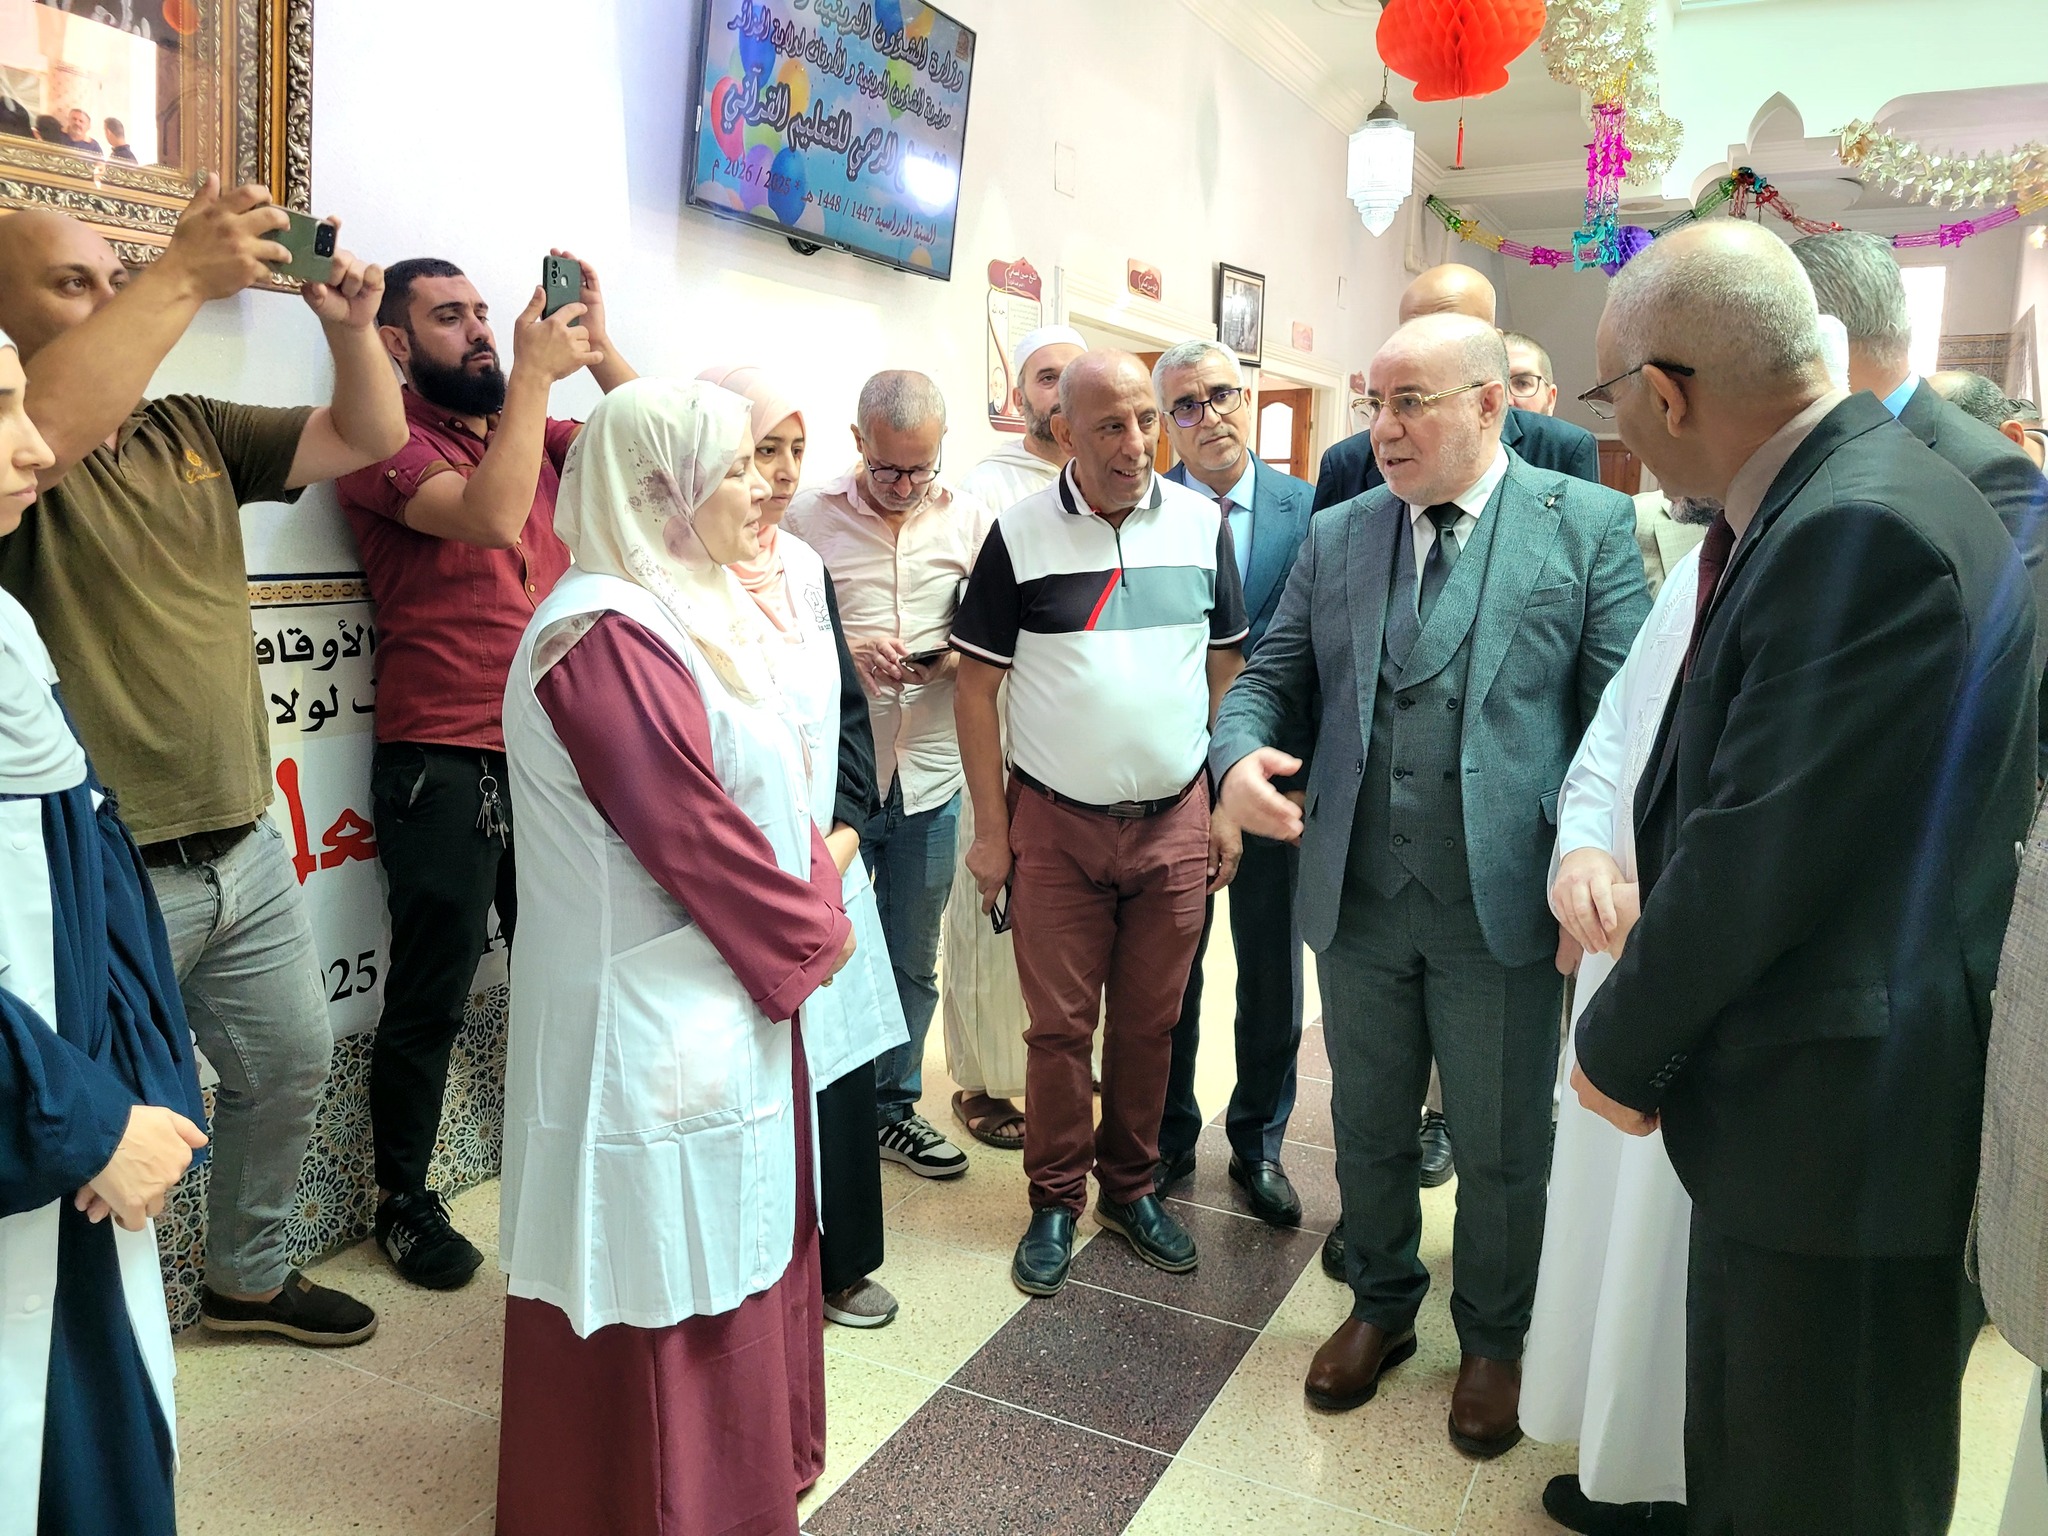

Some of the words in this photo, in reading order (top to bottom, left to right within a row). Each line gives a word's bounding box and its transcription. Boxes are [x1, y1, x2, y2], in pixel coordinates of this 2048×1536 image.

[804, 36, 847, 79] الأوقاف
[871, 21, 929, 70] الشؤون
[845, 64, 855, 85] و
[855, 62, 891, 99] الدينية
[928, 50, 963, 92] وزارة
[721, 64, 791, 134] القرآني
[890, 81, 925, 117] الشؤون
[923, 96, 951, 129] مديرية
[787, 99, 853, 153] للتعليم
[723, 157, 753, 181] 2026
[763, 172, 792, 195] 2025
[817, 189, 841, 212] 1448
[851, 200, 874, 219] 1447
[874, 206, 913, 237] الدراسية
[912, 222, 938, 246] السنة
